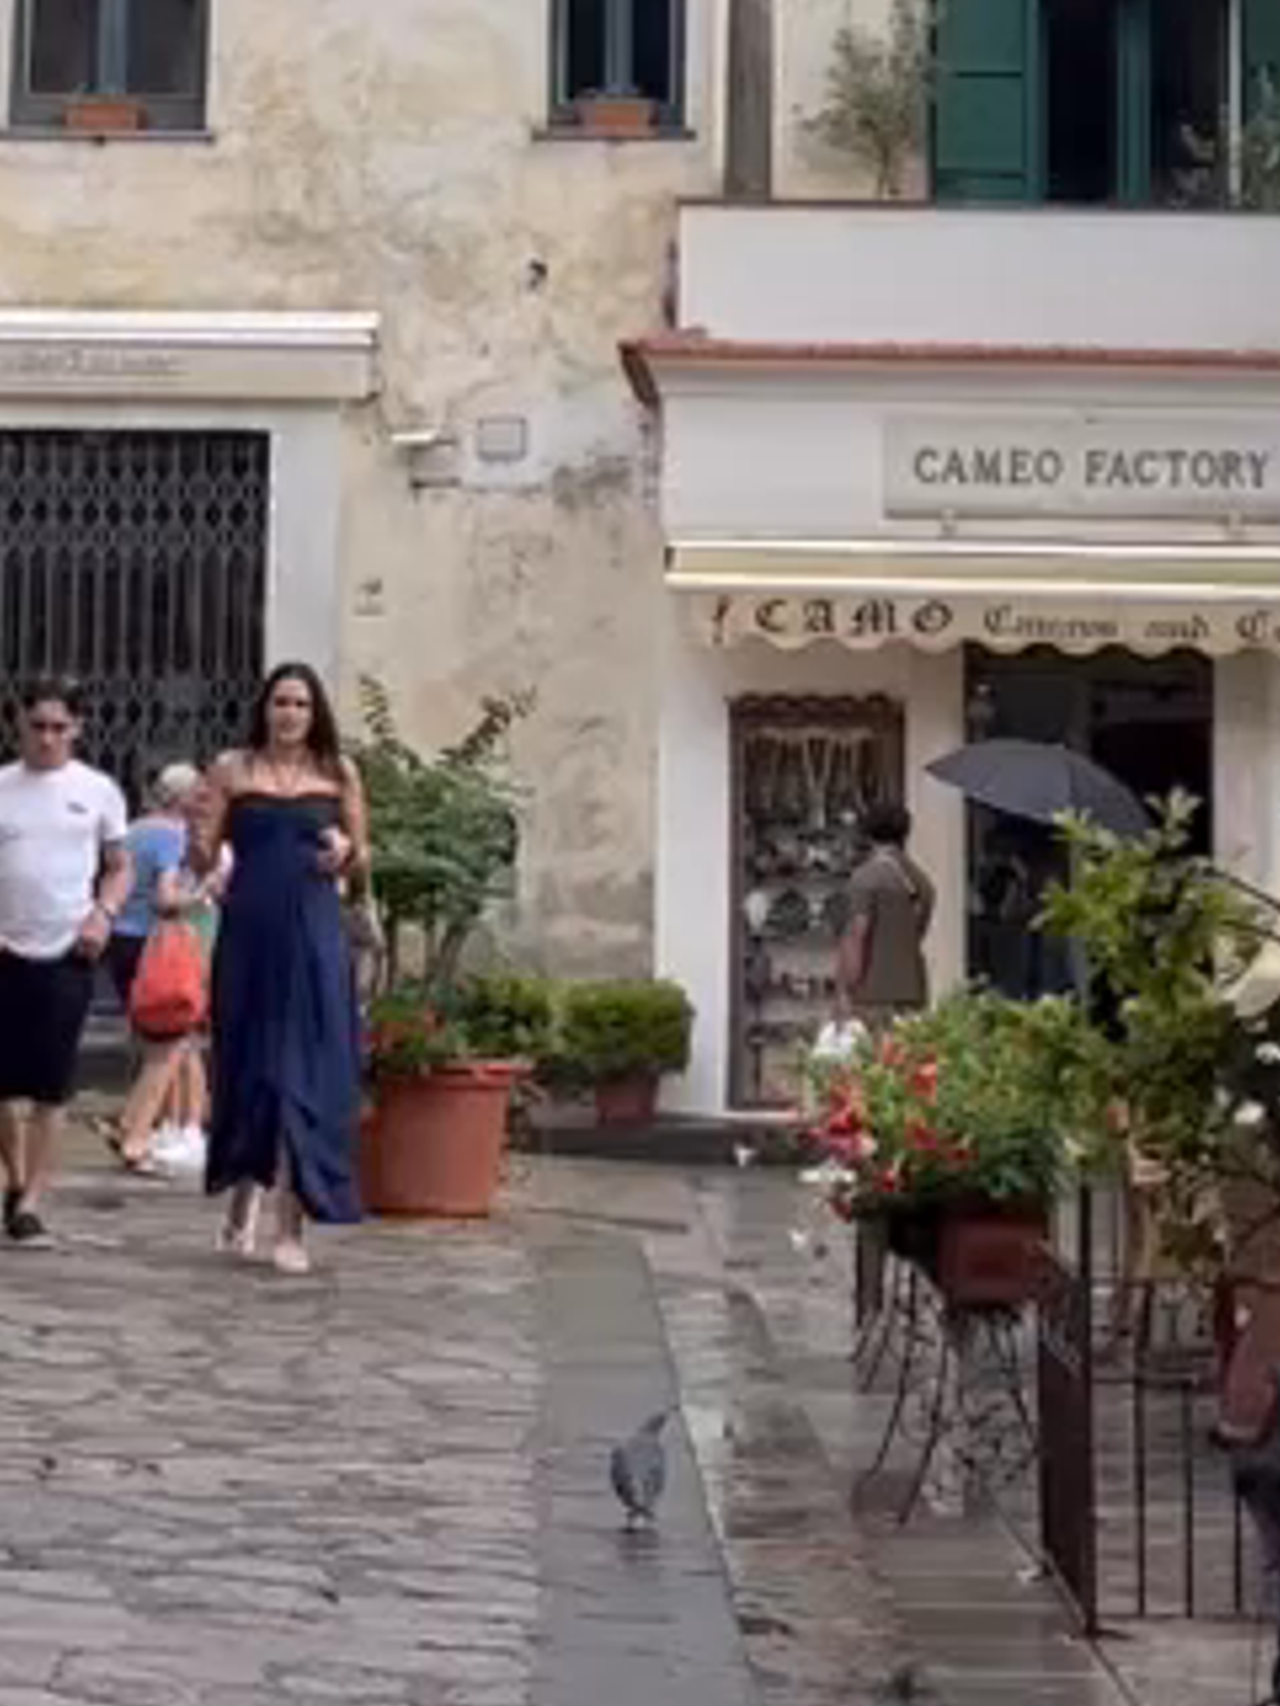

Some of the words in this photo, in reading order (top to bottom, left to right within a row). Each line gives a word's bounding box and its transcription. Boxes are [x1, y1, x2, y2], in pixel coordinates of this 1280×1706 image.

[913, 447, 1065, 486] CAMEO
[1084, 448, 1271, 489] FACTORY
[753, 597, 954, 635] CAMO
